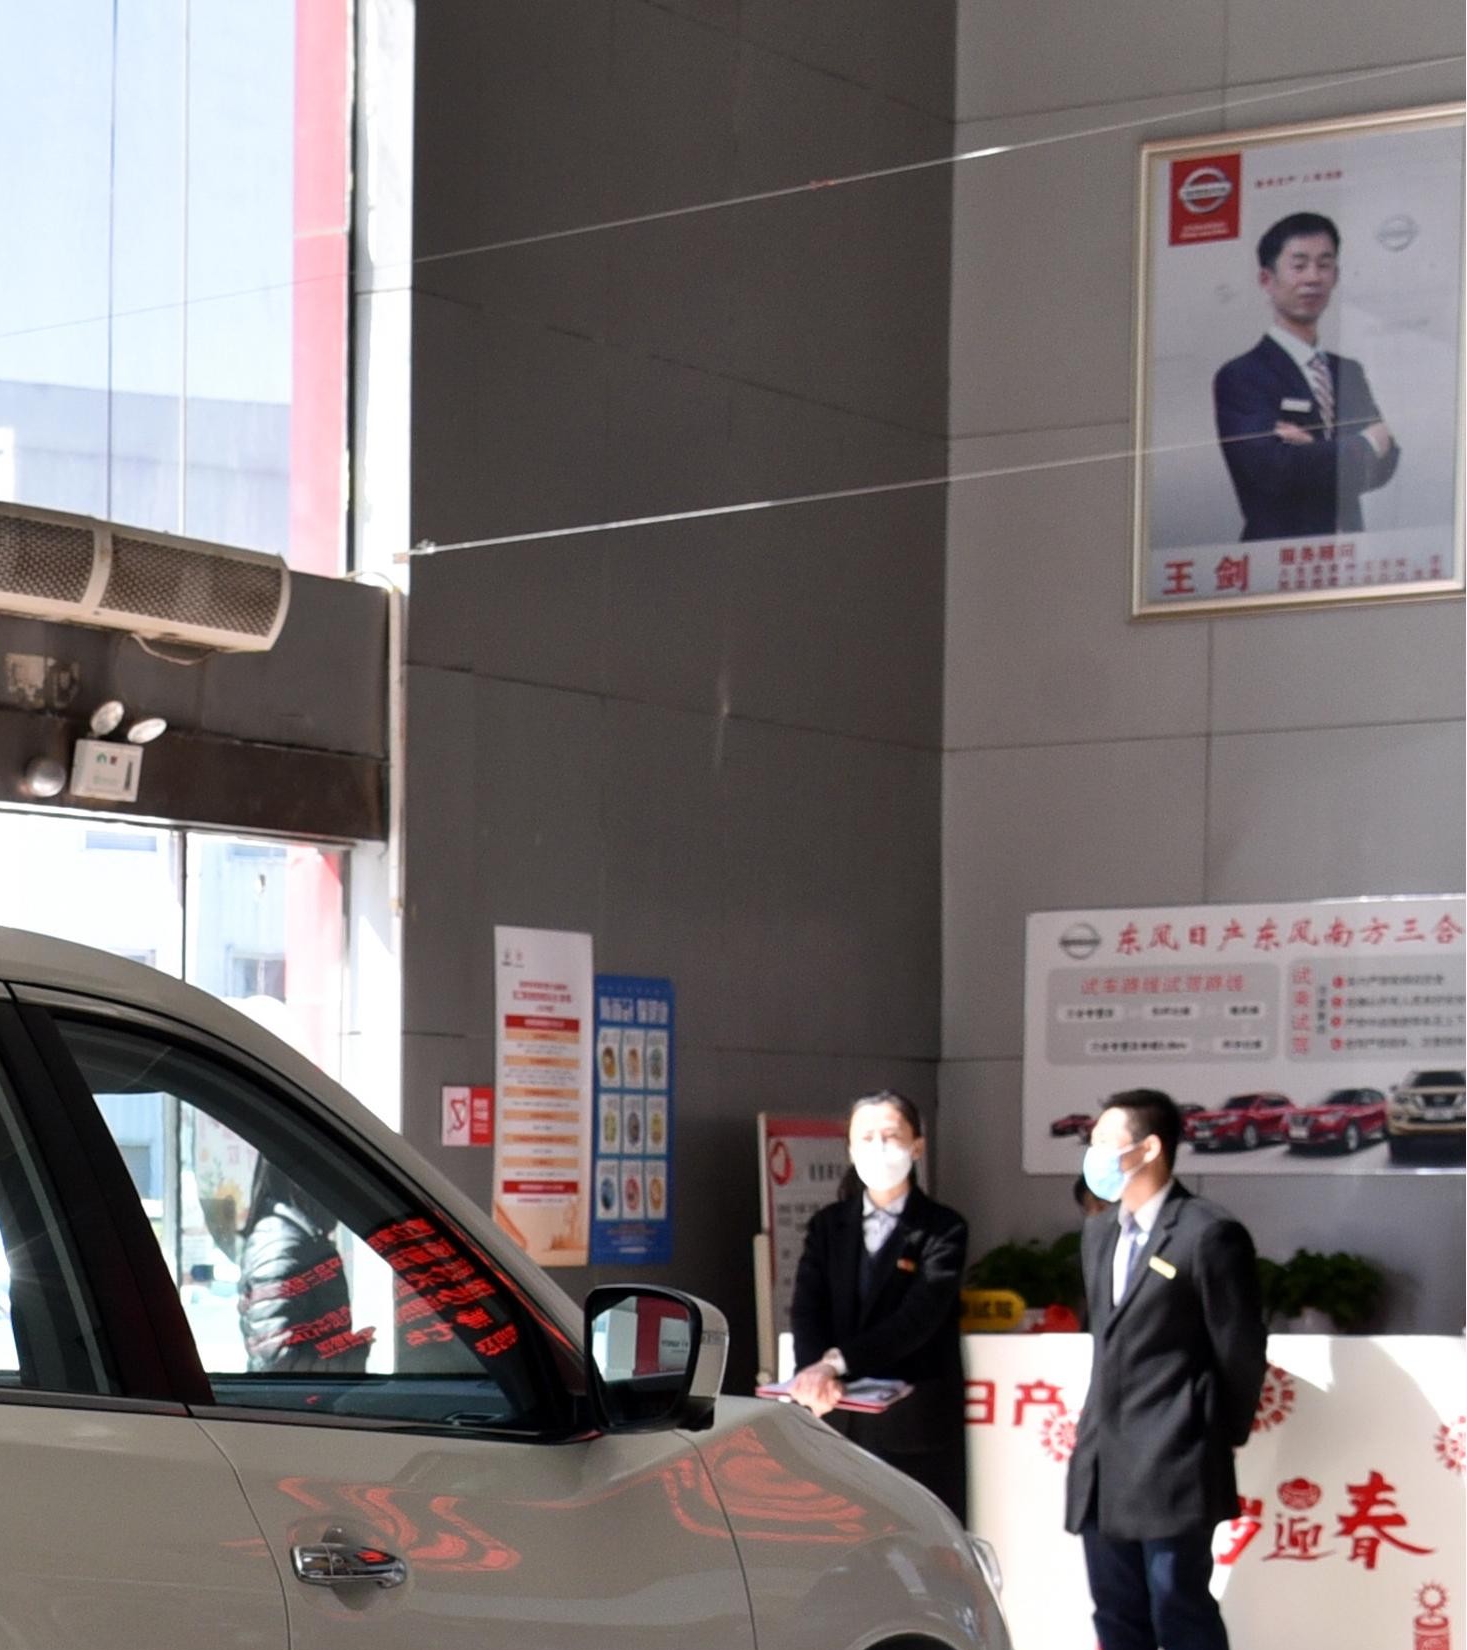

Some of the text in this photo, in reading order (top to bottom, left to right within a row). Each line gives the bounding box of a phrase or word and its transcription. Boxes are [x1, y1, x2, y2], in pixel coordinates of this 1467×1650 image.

[1116, 914, 1464, 955] 东风日产东风南方三合
